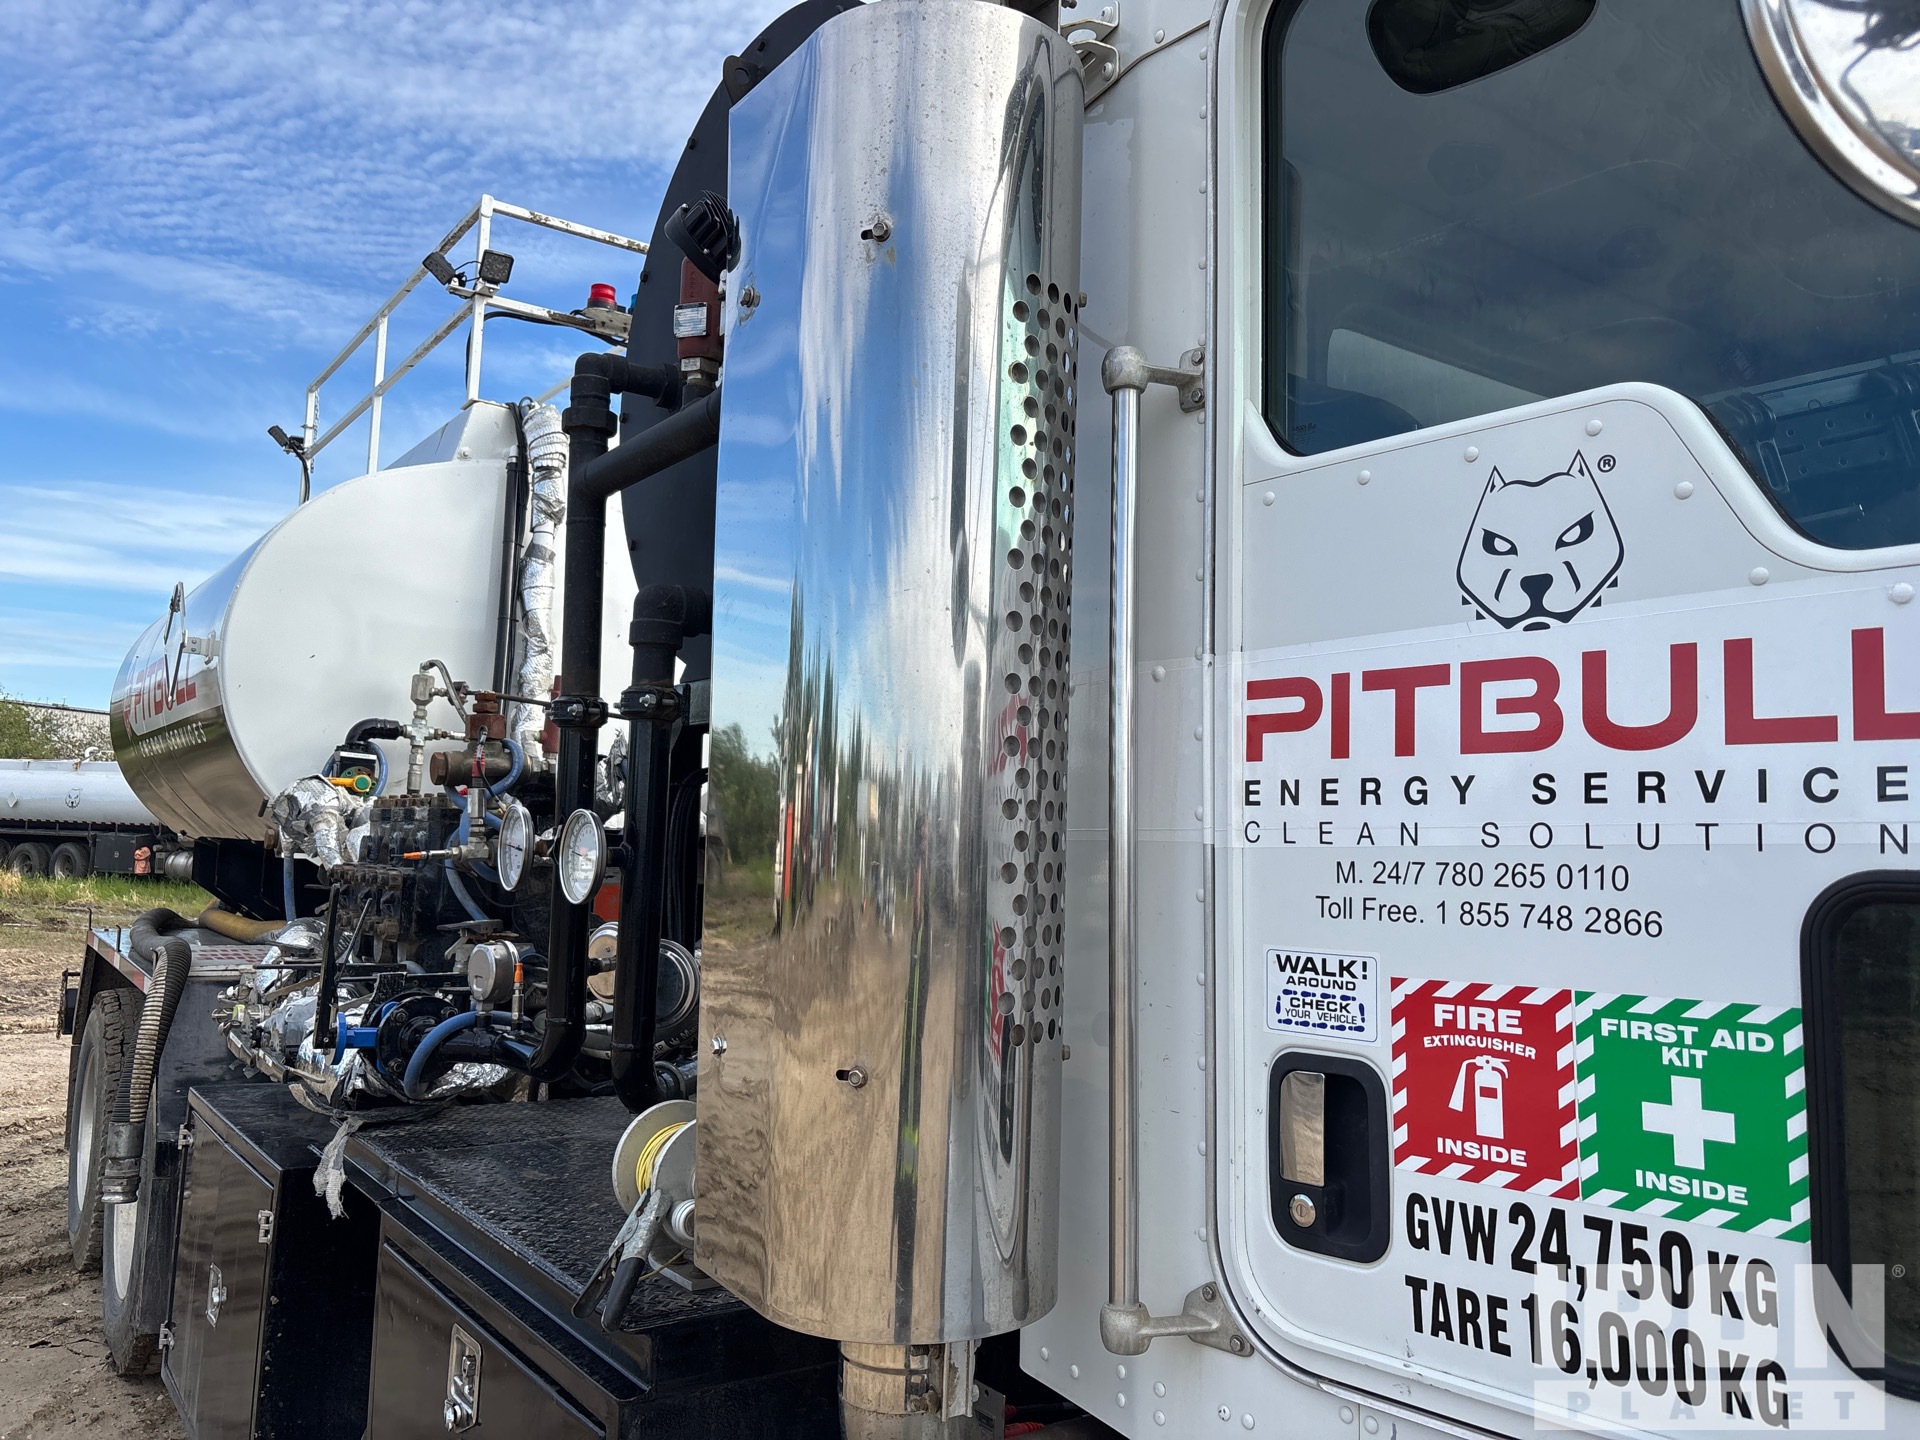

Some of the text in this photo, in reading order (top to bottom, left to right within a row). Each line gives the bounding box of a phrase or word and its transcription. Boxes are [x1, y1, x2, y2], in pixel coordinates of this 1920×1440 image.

[1246, 628, 1920, 762] PITBULL
[165, 721, 207, 751] SERVICES
[1245, 766, 1908, 806] ENERGY SERVICE
[1245, 821, 1907, 854] CLEAN SOLUTION
[1336, 861, 1628, 891] M. 24/7 780 265 0110
[1316, 896, 1662, 937] Toll Free. 1 855 748 2866
[1276, 954, 1367, 980] WALK!
[1286, 976, 1356, 991] AROUND
[1285, 1008, 1357, 1025] YOUR VEHICLE
[1290, 997, 1351, 1014] CHECK
[1434, 1003, 1522, 1035] FIRE
[1423, 1034, 1537, 1060] EXTINGUISHER
[1600, 1017, 1773, 1052] FIRST AID
[1662, 1046, 1707, 1068] KIT
[1437, 1137, 1527, 1167] INSIDE
[1635, 1169, 1748, 1206] INSIDE
[1406, 1193, 1778, 1328] GVW 24,750 KG
[1405, 1275, 1791, 1430] TARE 16,000 KG
